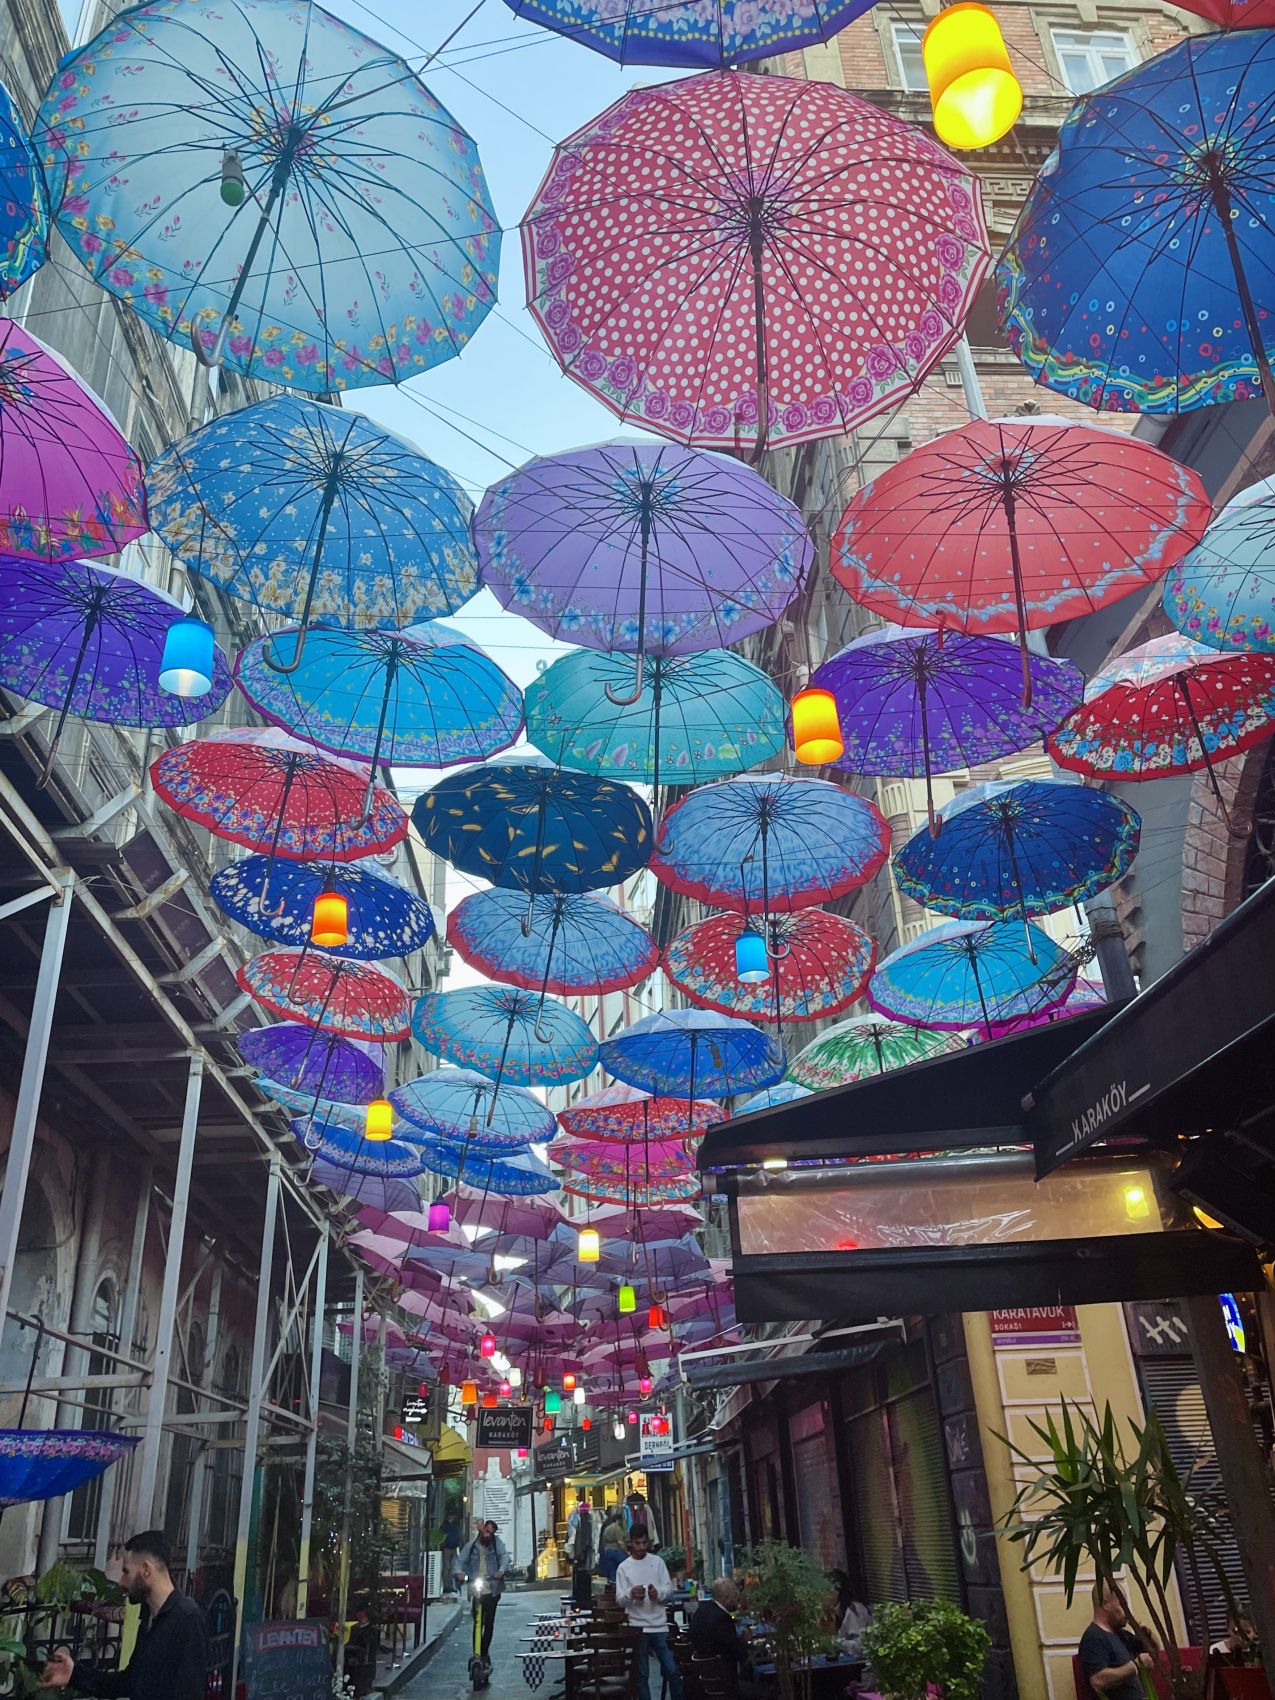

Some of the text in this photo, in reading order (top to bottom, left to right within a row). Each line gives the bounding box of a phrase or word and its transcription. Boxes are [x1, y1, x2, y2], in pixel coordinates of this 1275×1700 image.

[1072, 1080, 1127, 1143] KARAKÖY
[993, 1306, 1065, 1320] KARATAVUK
[994, 1322, 1022, 1331] SOKAĞI
[483, 1411, 526, 1431] levanten
[489, 1431, 519, 1439] KARAKÖY
[537, 1449, 570, 1462] levanten
[259, 1628, 318, 1649] LEVANTEN
